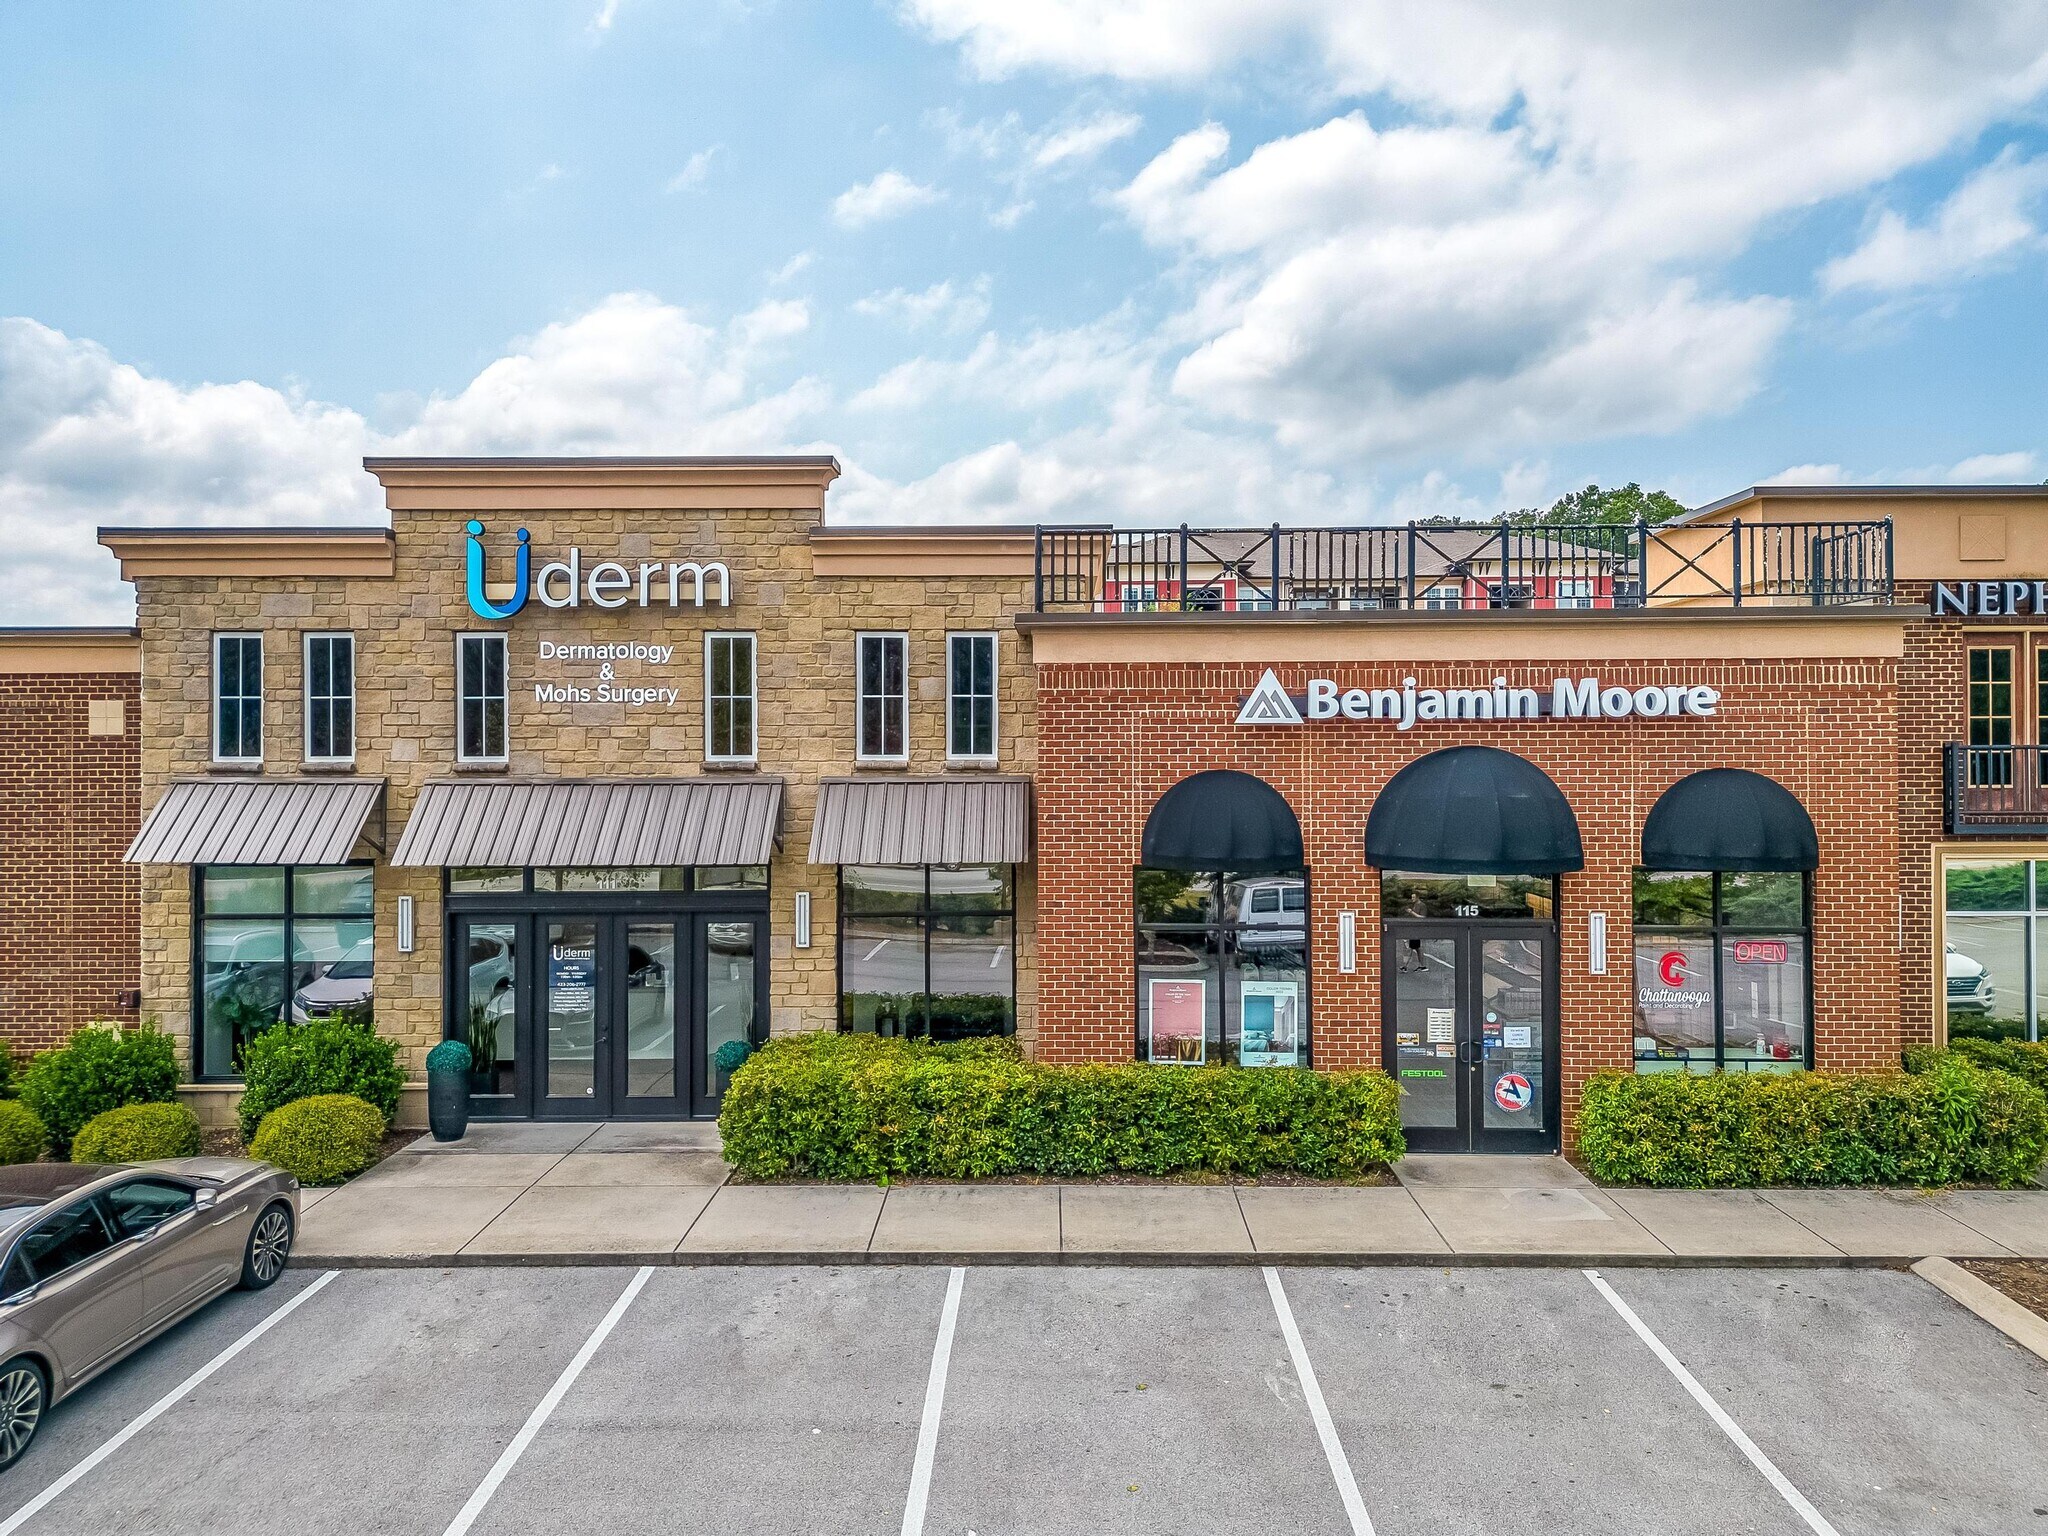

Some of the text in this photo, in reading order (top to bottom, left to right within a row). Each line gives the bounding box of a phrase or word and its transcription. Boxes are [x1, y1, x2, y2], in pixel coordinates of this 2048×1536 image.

[466, 519, 732, 620] Uderm
[539, 641, 675, 664] Dermatology
[599, 662, 615, 681] &
[535, 684, 679, 706] Mohs Surgery
[1307, 676, 1720, 731] Benjamin Moore
[596, 879, 617, 889] 111
[1455, 905, 1480, 917] 115
[553, 944, 591, 961] Uderm
[1737, 944, 1785, 961] OPEN
[1639, 987, 1711, 1008] Chattanooga
[1401, 1069, 1447, 1078] FESTOOL
